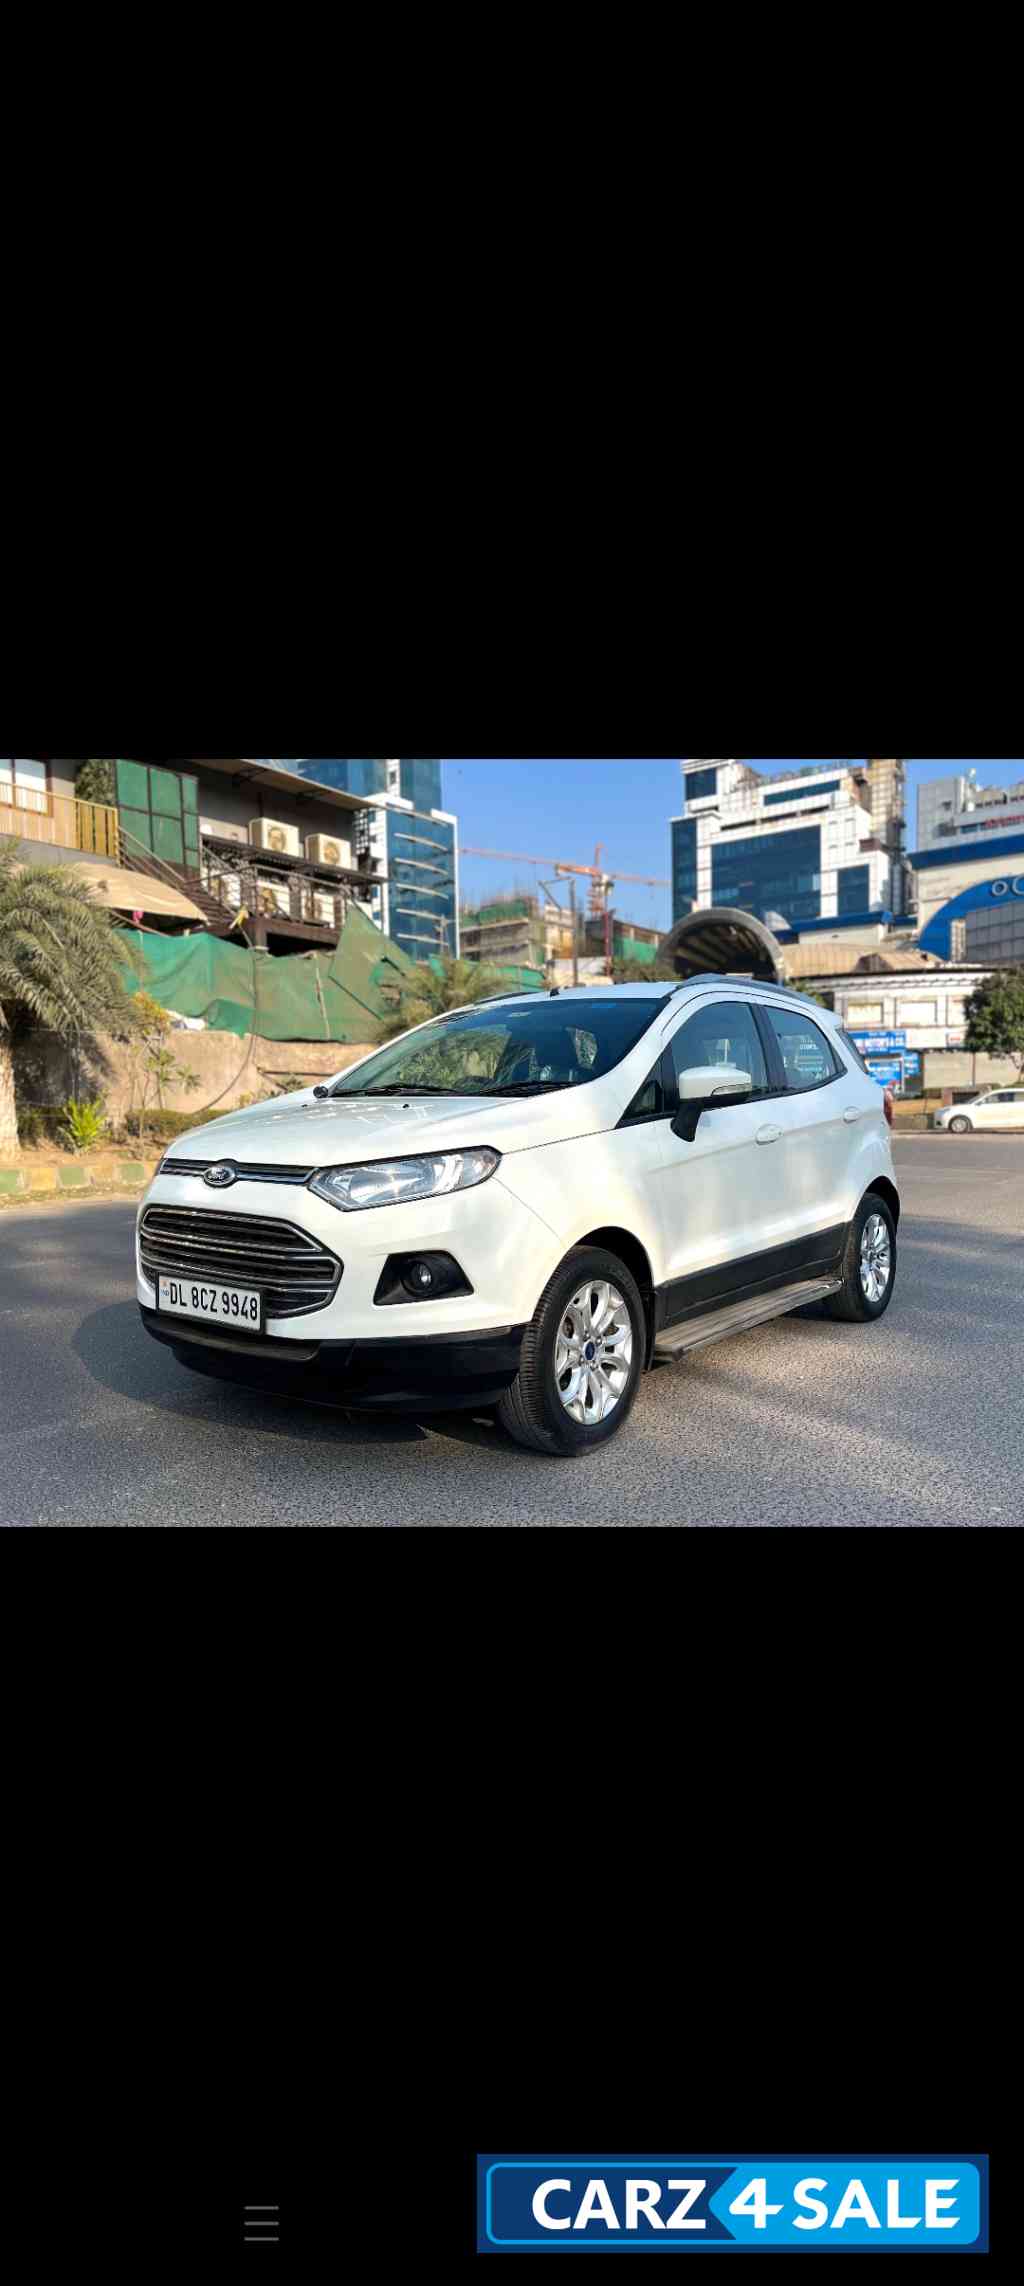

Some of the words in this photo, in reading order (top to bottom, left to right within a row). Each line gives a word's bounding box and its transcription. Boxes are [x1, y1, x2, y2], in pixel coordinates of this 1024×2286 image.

[169, 1282, 188, 1307] DL
[191, 1286, 218, 1313] 8CZ
[221, 1291, 258, 1321] 9948
